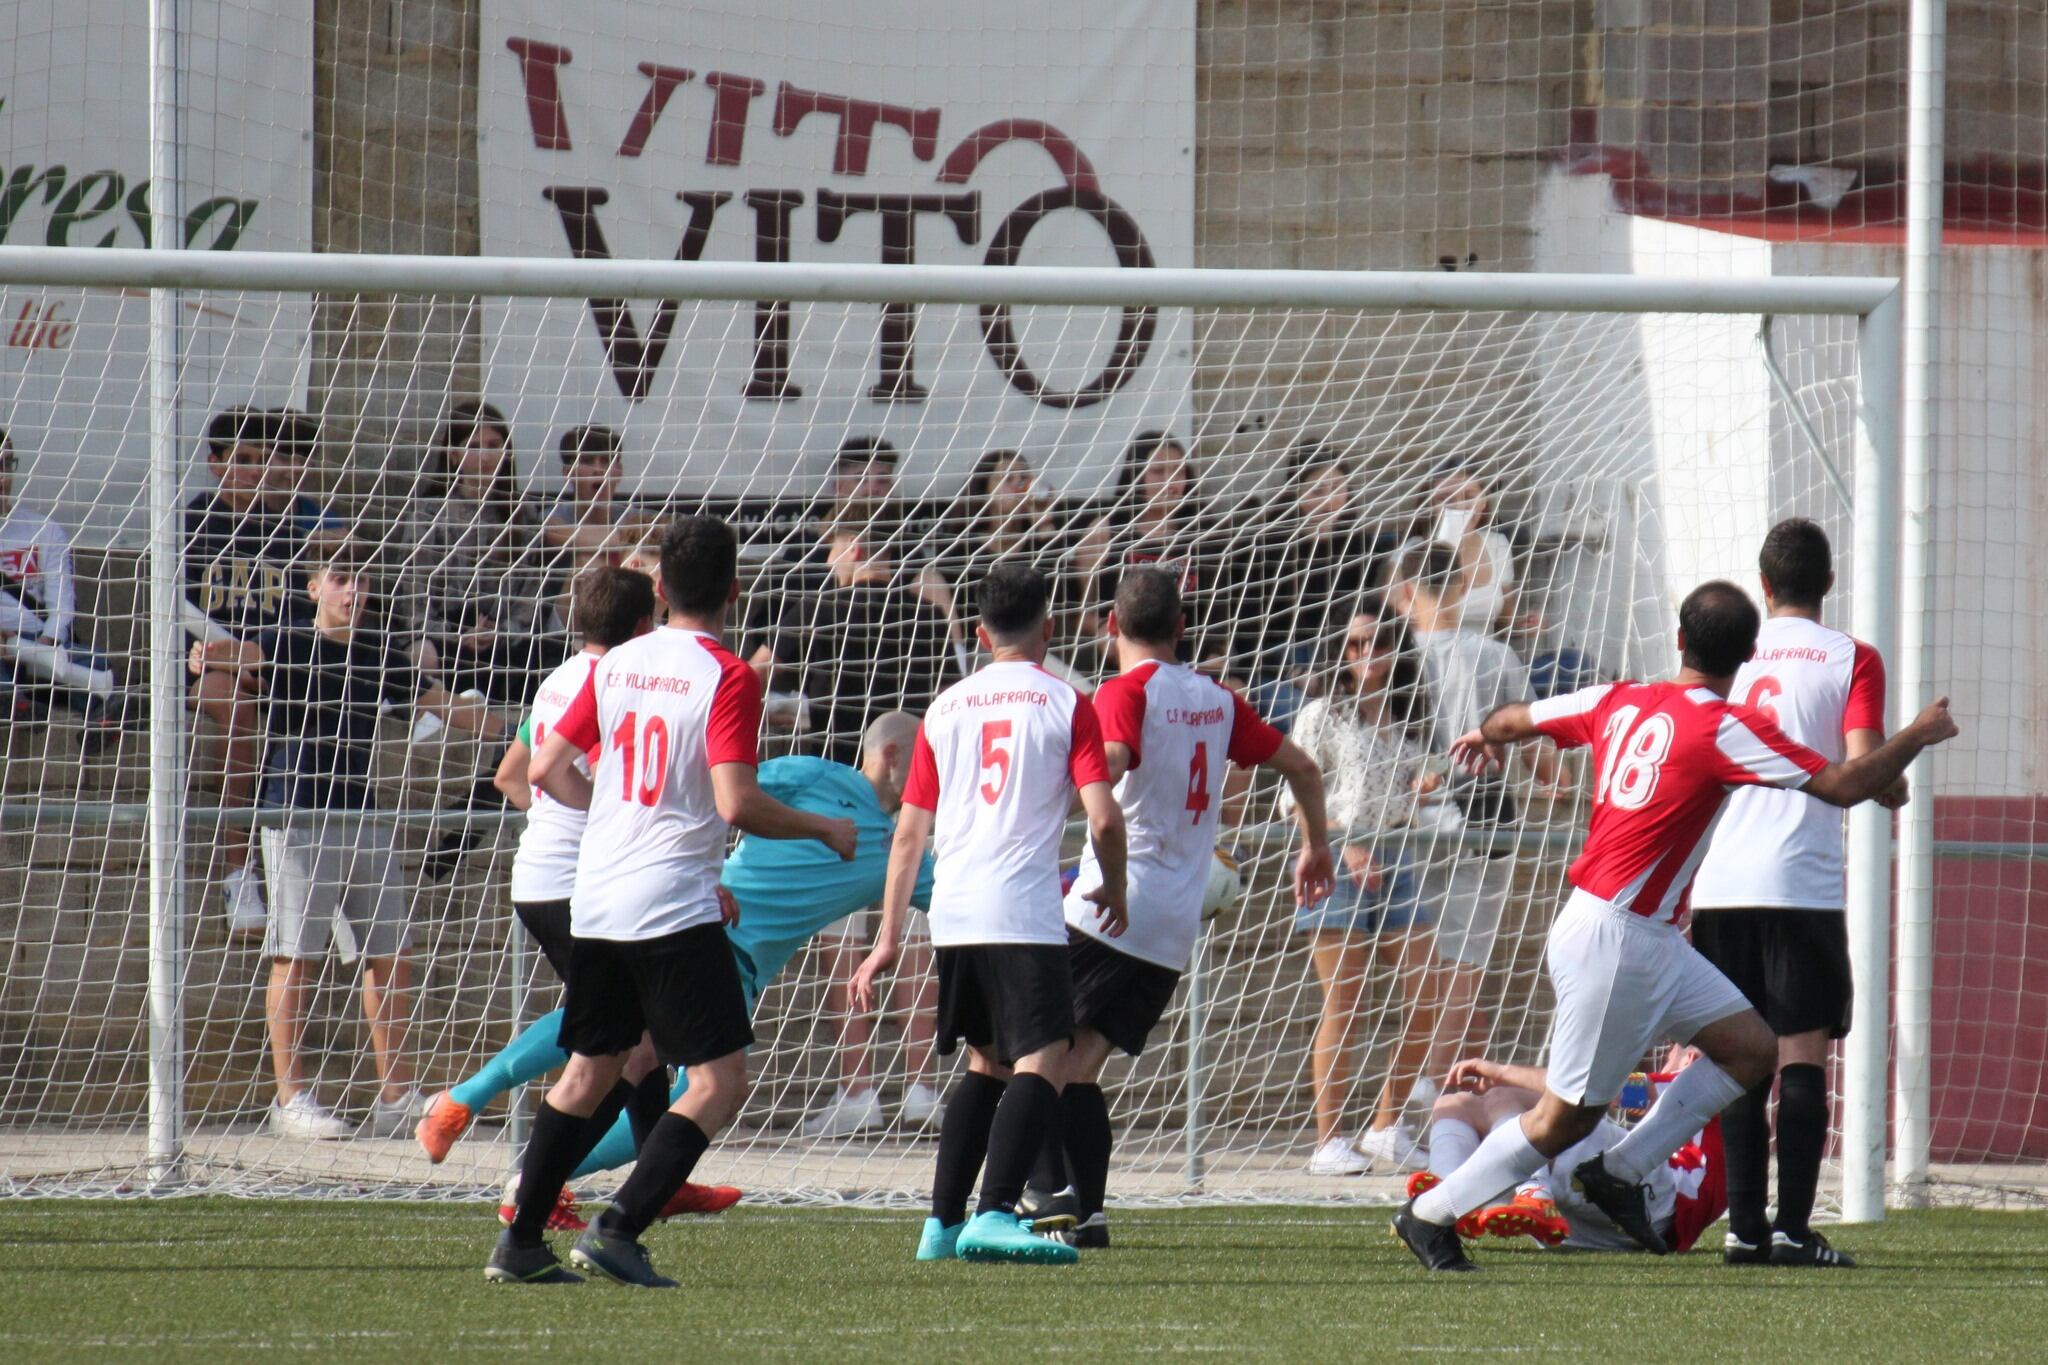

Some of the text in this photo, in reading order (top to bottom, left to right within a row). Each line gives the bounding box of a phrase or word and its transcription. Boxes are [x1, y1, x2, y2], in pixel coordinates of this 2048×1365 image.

[8, 299, 73, 357] life
[542, 186, 1157, 408] VITO
[200, 557, 288, 614] GAP
[625, 672, 691, 696] VILLAFRANCA
[966, 690, 1048, 708] VILLAFRANCA
[613, 711, 668, 807] 10
[981, 720, 1012, 806] 5
[1185, 741, 1210, 826] 4
[1596, 704, 1675, 810] 18
